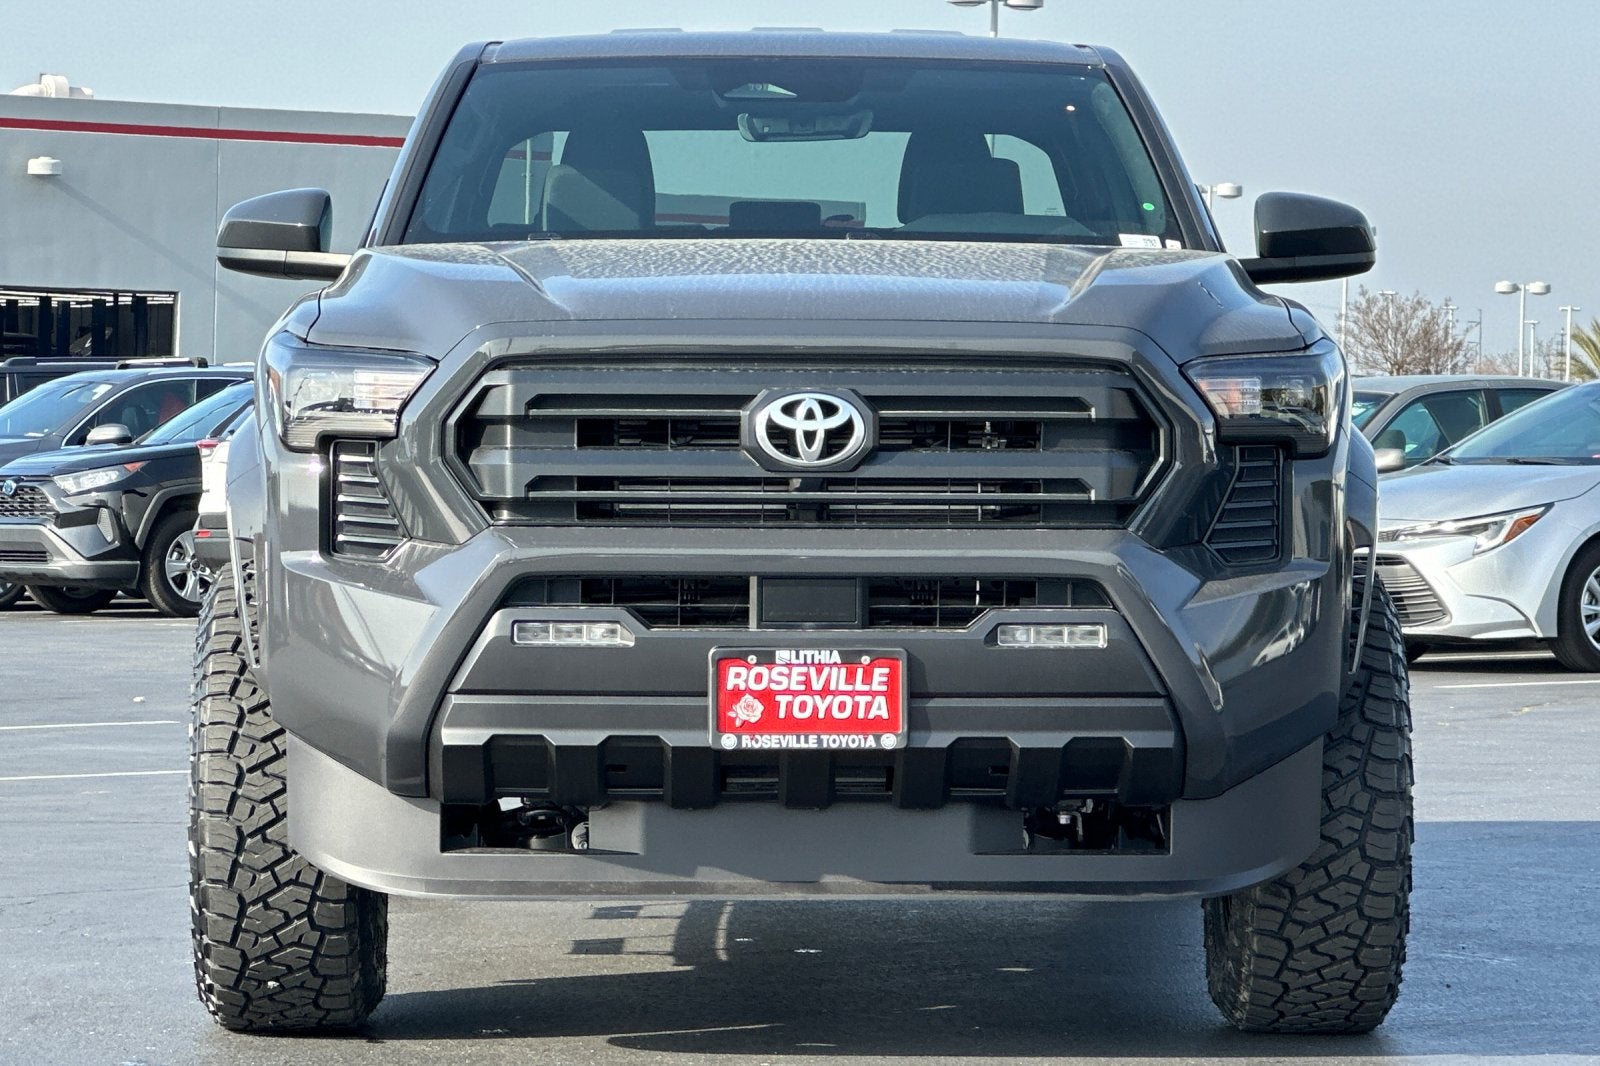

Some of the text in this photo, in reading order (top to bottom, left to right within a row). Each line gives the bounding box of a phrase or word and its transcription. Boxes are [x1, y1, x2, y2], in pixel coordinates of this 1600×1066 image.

[790, 650, 841, 664] LITHIA
[727, 666, 890, 691] ROSEVILLE
[775, 695, 889, 719] TOYOTA
[742, 735, 876, 748] ROSEVILLE TOYOTA
